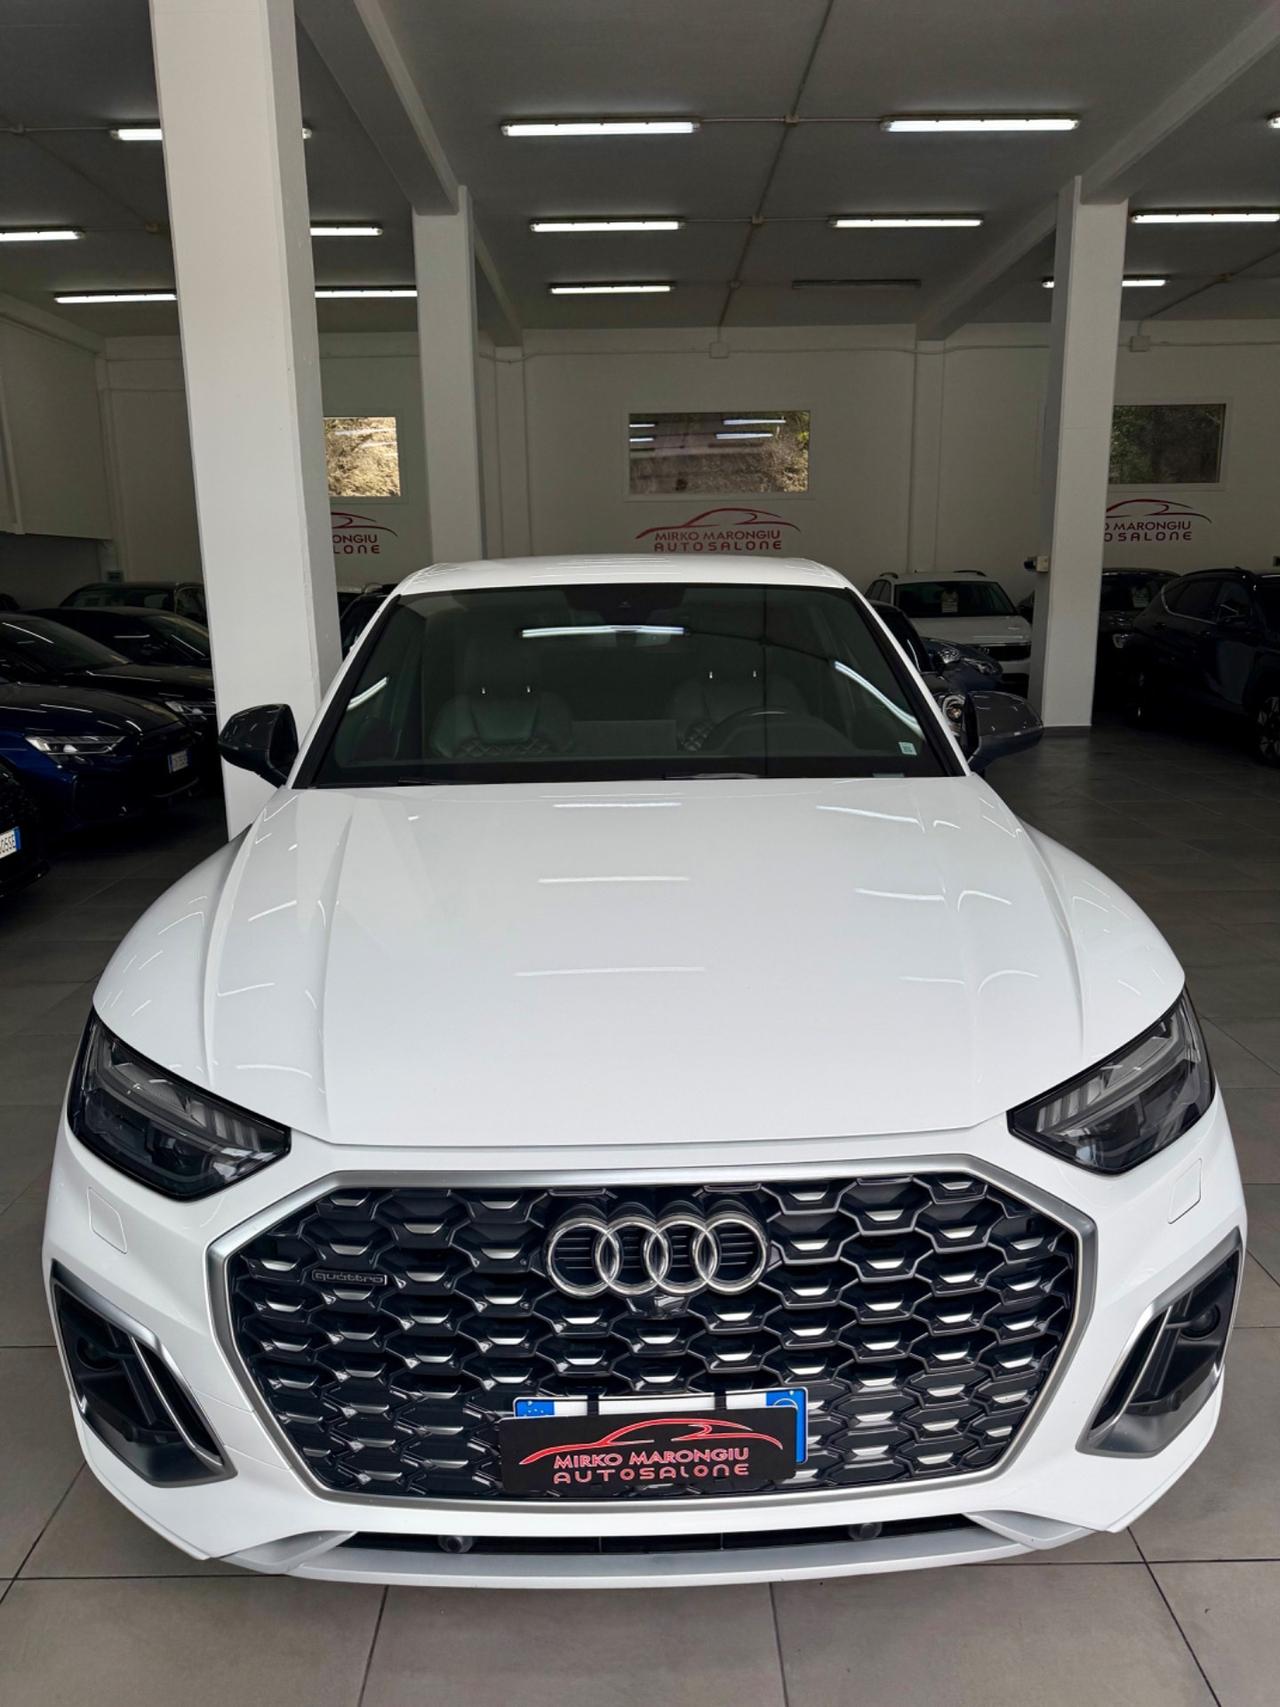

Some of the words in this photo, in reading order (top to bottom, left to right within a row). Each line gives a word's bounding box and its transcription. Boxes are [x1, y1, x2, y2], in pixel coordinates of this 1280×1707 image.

[1113, 521, 1191, 531] MARONGIU
[655, 530, 699, 541] MIRKO
[702, 530, 781, 541] MARONGIU
[654, 541, 782, 552] AUTOSALONE
[553, 1452, 624, 1470] MIRKO
[629, 1447, 750, 1465] MARONGIU
[553, 1463, 750, 1485] AUTOSALONE
